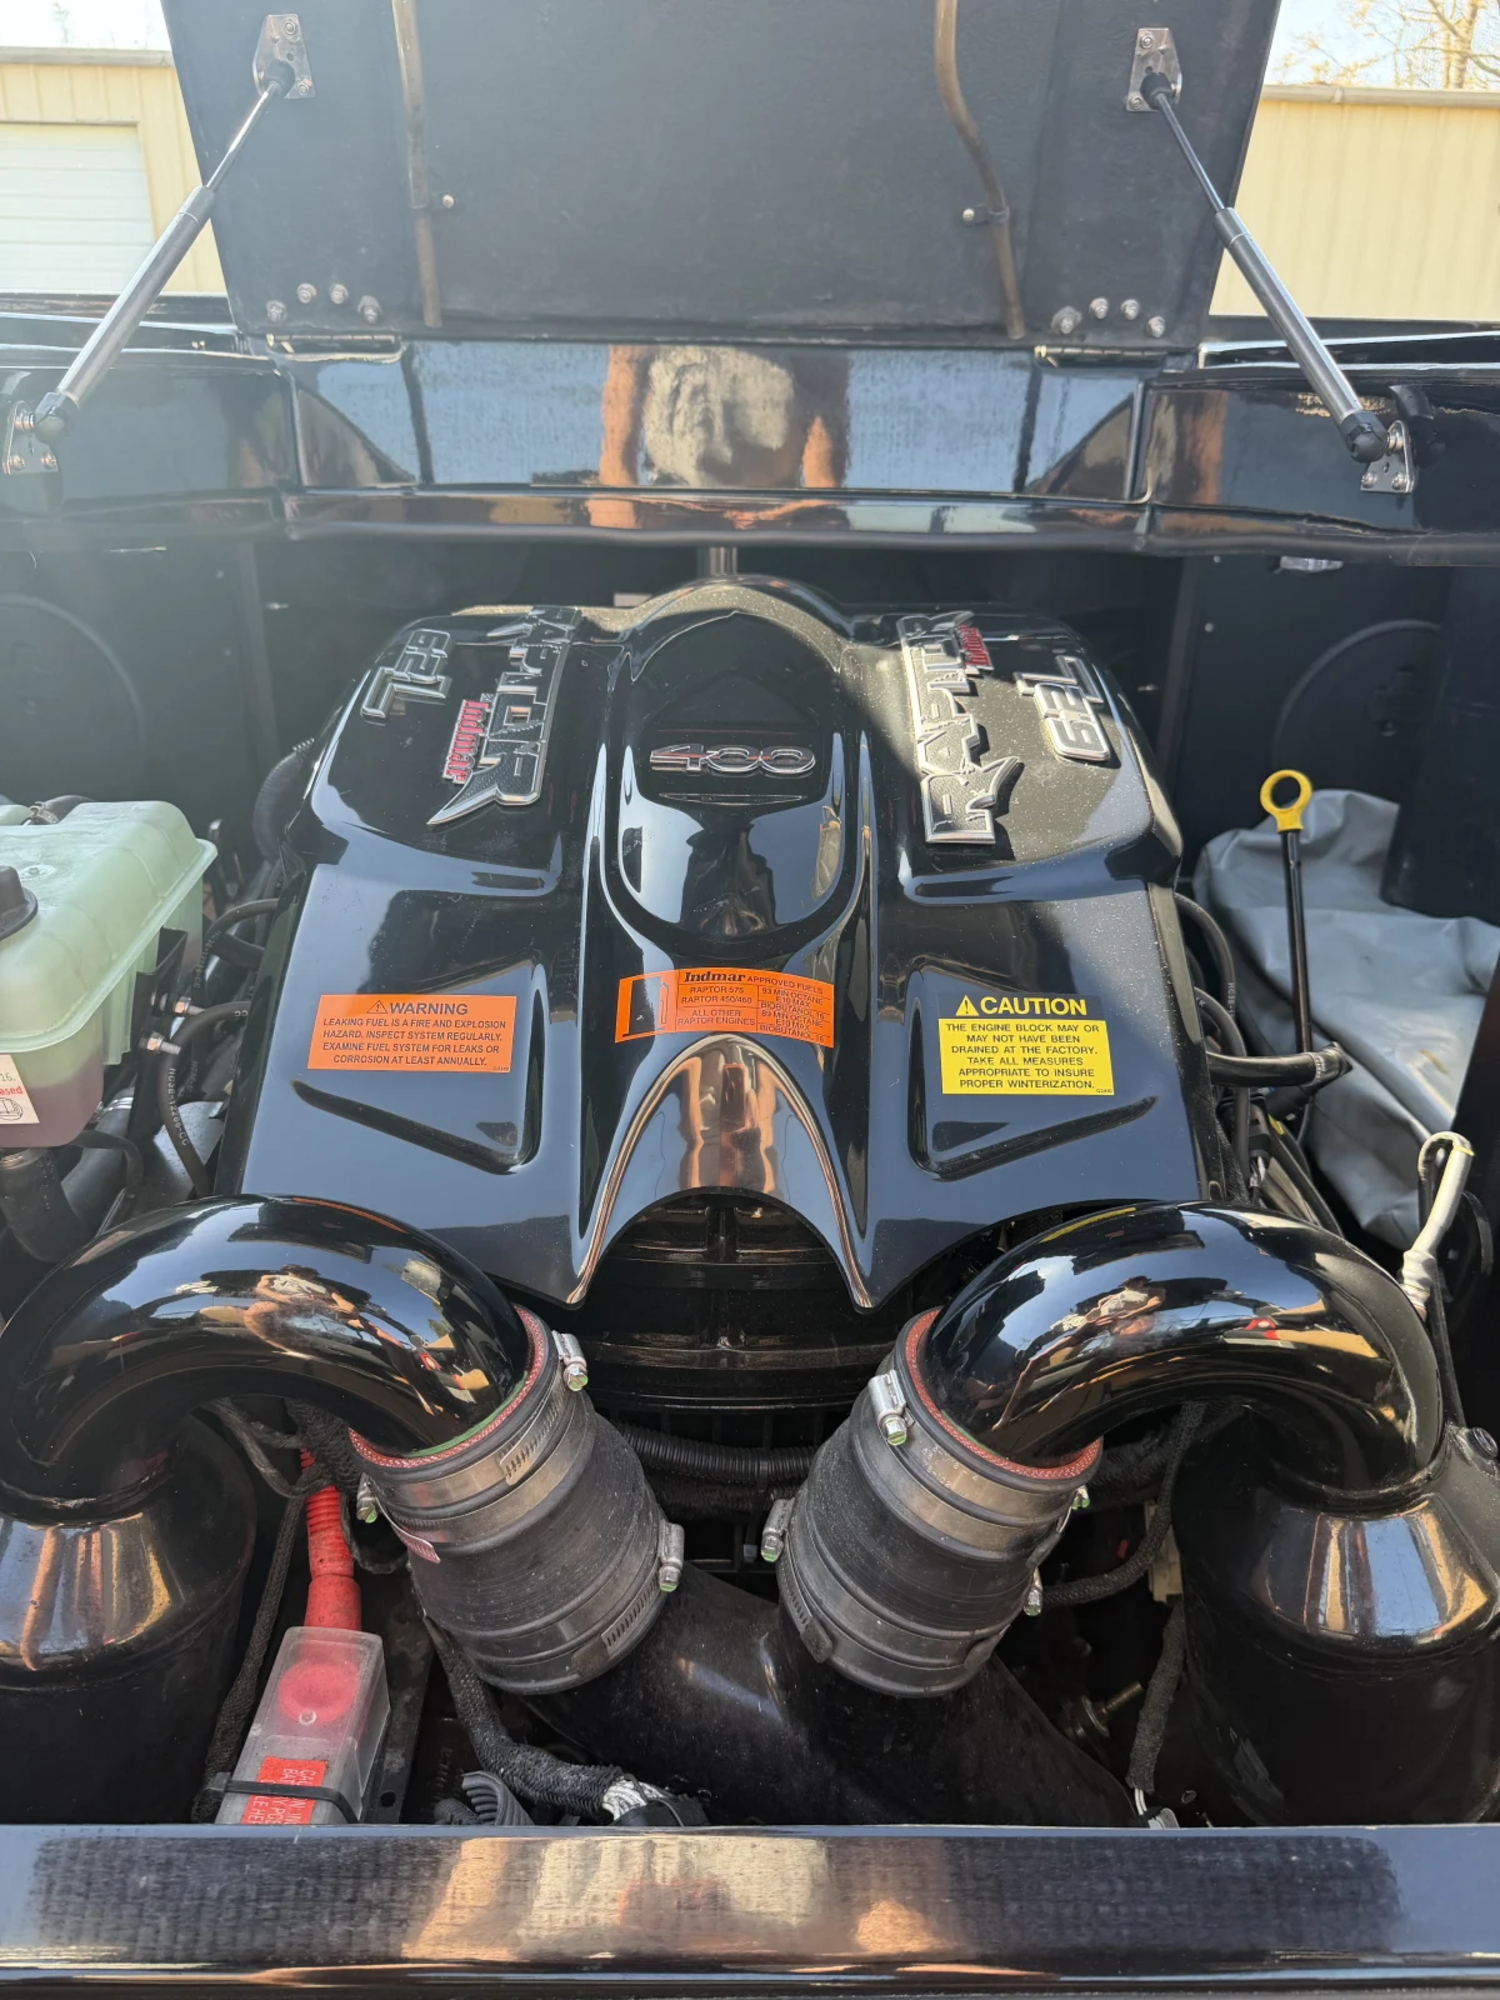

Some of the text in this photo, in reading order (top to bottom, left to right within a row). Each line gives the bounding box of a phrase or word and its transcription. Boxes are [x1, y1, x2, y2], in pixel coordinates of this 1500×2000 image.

[427, 605, 582, 826] RAPTOR
[897, 610, 1020, 844] RAPTOR
[649, 743, 816, 775] 400
[684, 971, 823, 994] Indmar APPROVED FUELS
[690, 986, 726, 994] RAPTOR
[681, 996, 718, 1004] RAPTOR
[776, 996, 809, 1007] E10 MAX
[791, 992, 823, 1005] OCTANE
[390, 1002, 468, 1016] WARNING
[760, 1001, 812, 1017] BIOBUTANOL
[980, 996, 1087, 1016] CAUTION
[323, 1018, 506, 1029] LEAKING FUEL IS A FIRE AND EXPLOSION
[678, 1017, 755, 1025] RAPTOR ENGINES
[773, 1011, 788, 1019] MIN
[790, 1015, 823, 1028] OCTANE
[946, 1023, 966, 1031] THE
[971, 1024, 1011, 1032] ENGINE
[1016, 1024, 1052, 1032] BLOCK
[1084, 1025, 1099, 1033] OR
[323, 1030, 502, 1042] HAZARD. INSPECT SYSTEM REGULARLY.
[993, 1035, 1014, 1043] NOT
[1019, 1035, 1046, 1043] HAVE
[1051, 1035, 1080, 1043] BEEN
[323, 1042, 500, 1054] EXAMINE FUEL SYSTEM FOR LEAKS OR
[951, 1046, 1098, 1054] DRAINED AT THE FACTORY.
[333, 1055, 487, 1066] CORROSION AT LEAST ANNUALLY.
[967, 1057, 1083, 1065] TAKE ALL MEASURES
[958, 1068, 1095, 1077] APPROPRIATE TO INSURE
[960, 1080, 1095, 1089] PROPER WINTERIZATION.
